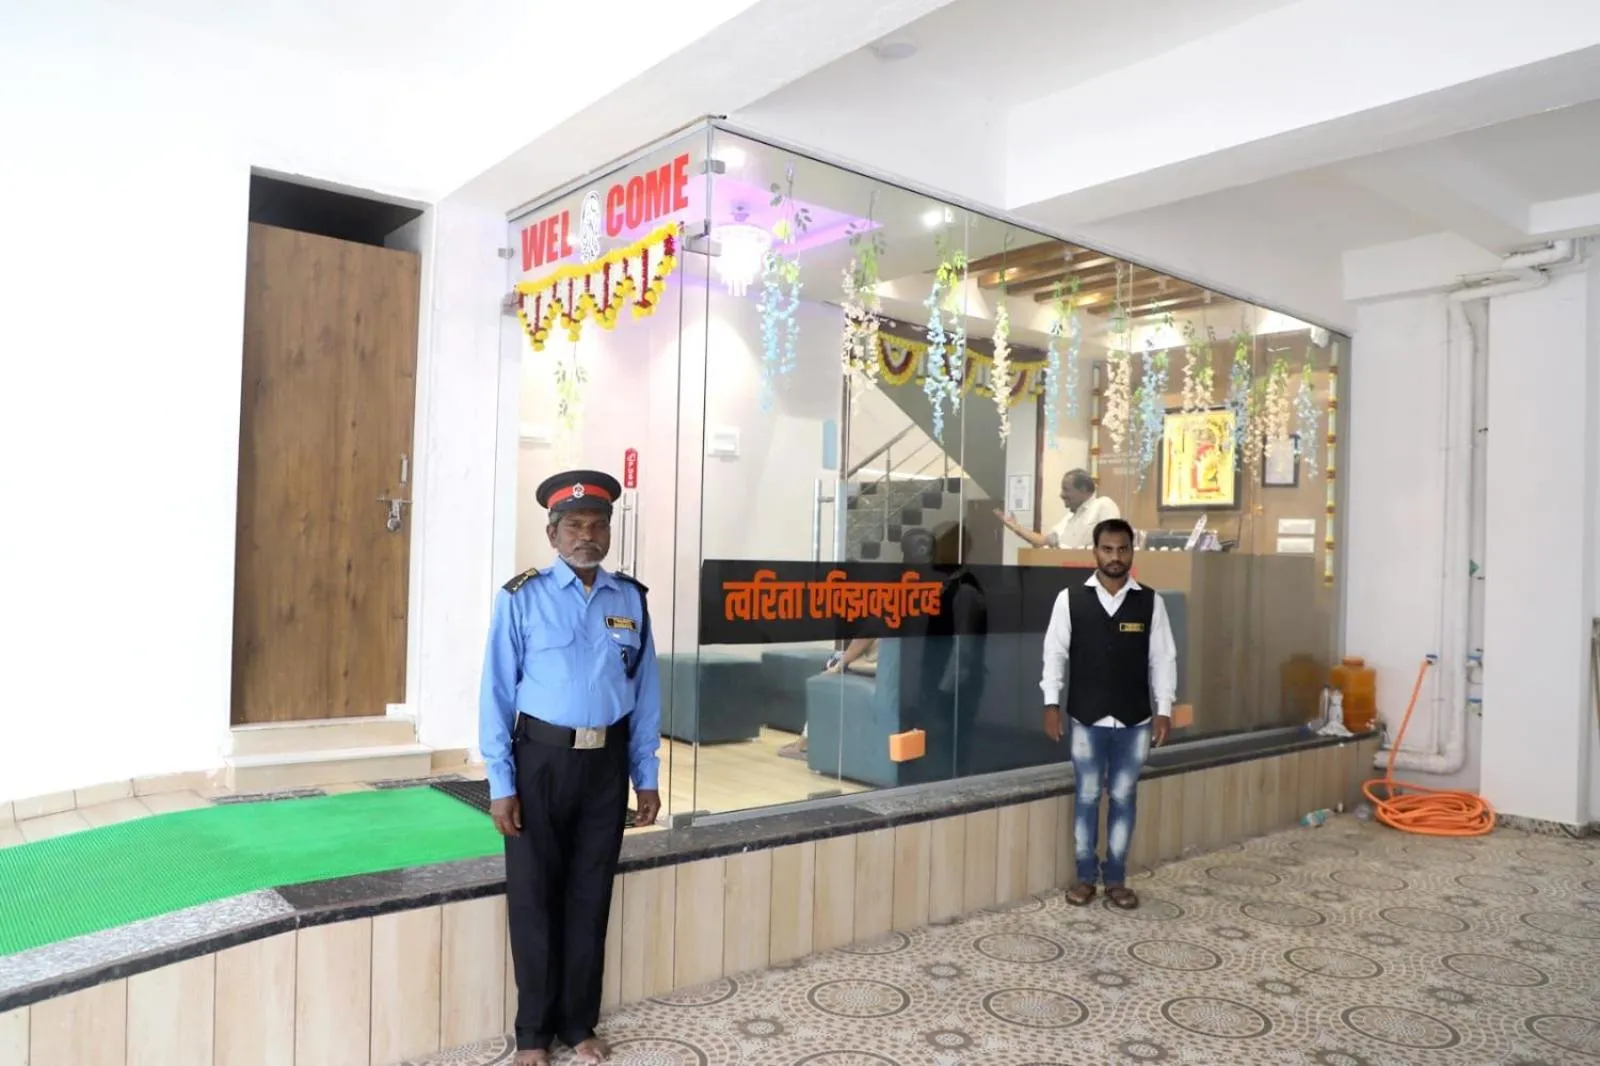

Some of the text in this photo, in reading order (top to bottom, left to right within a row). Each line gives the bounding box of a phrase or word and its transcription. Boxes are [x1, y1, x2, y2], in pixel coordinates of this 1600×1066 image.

[521, 153, 689, 272] WEL COME
[723, 569, 806, 621] त्वरिता
